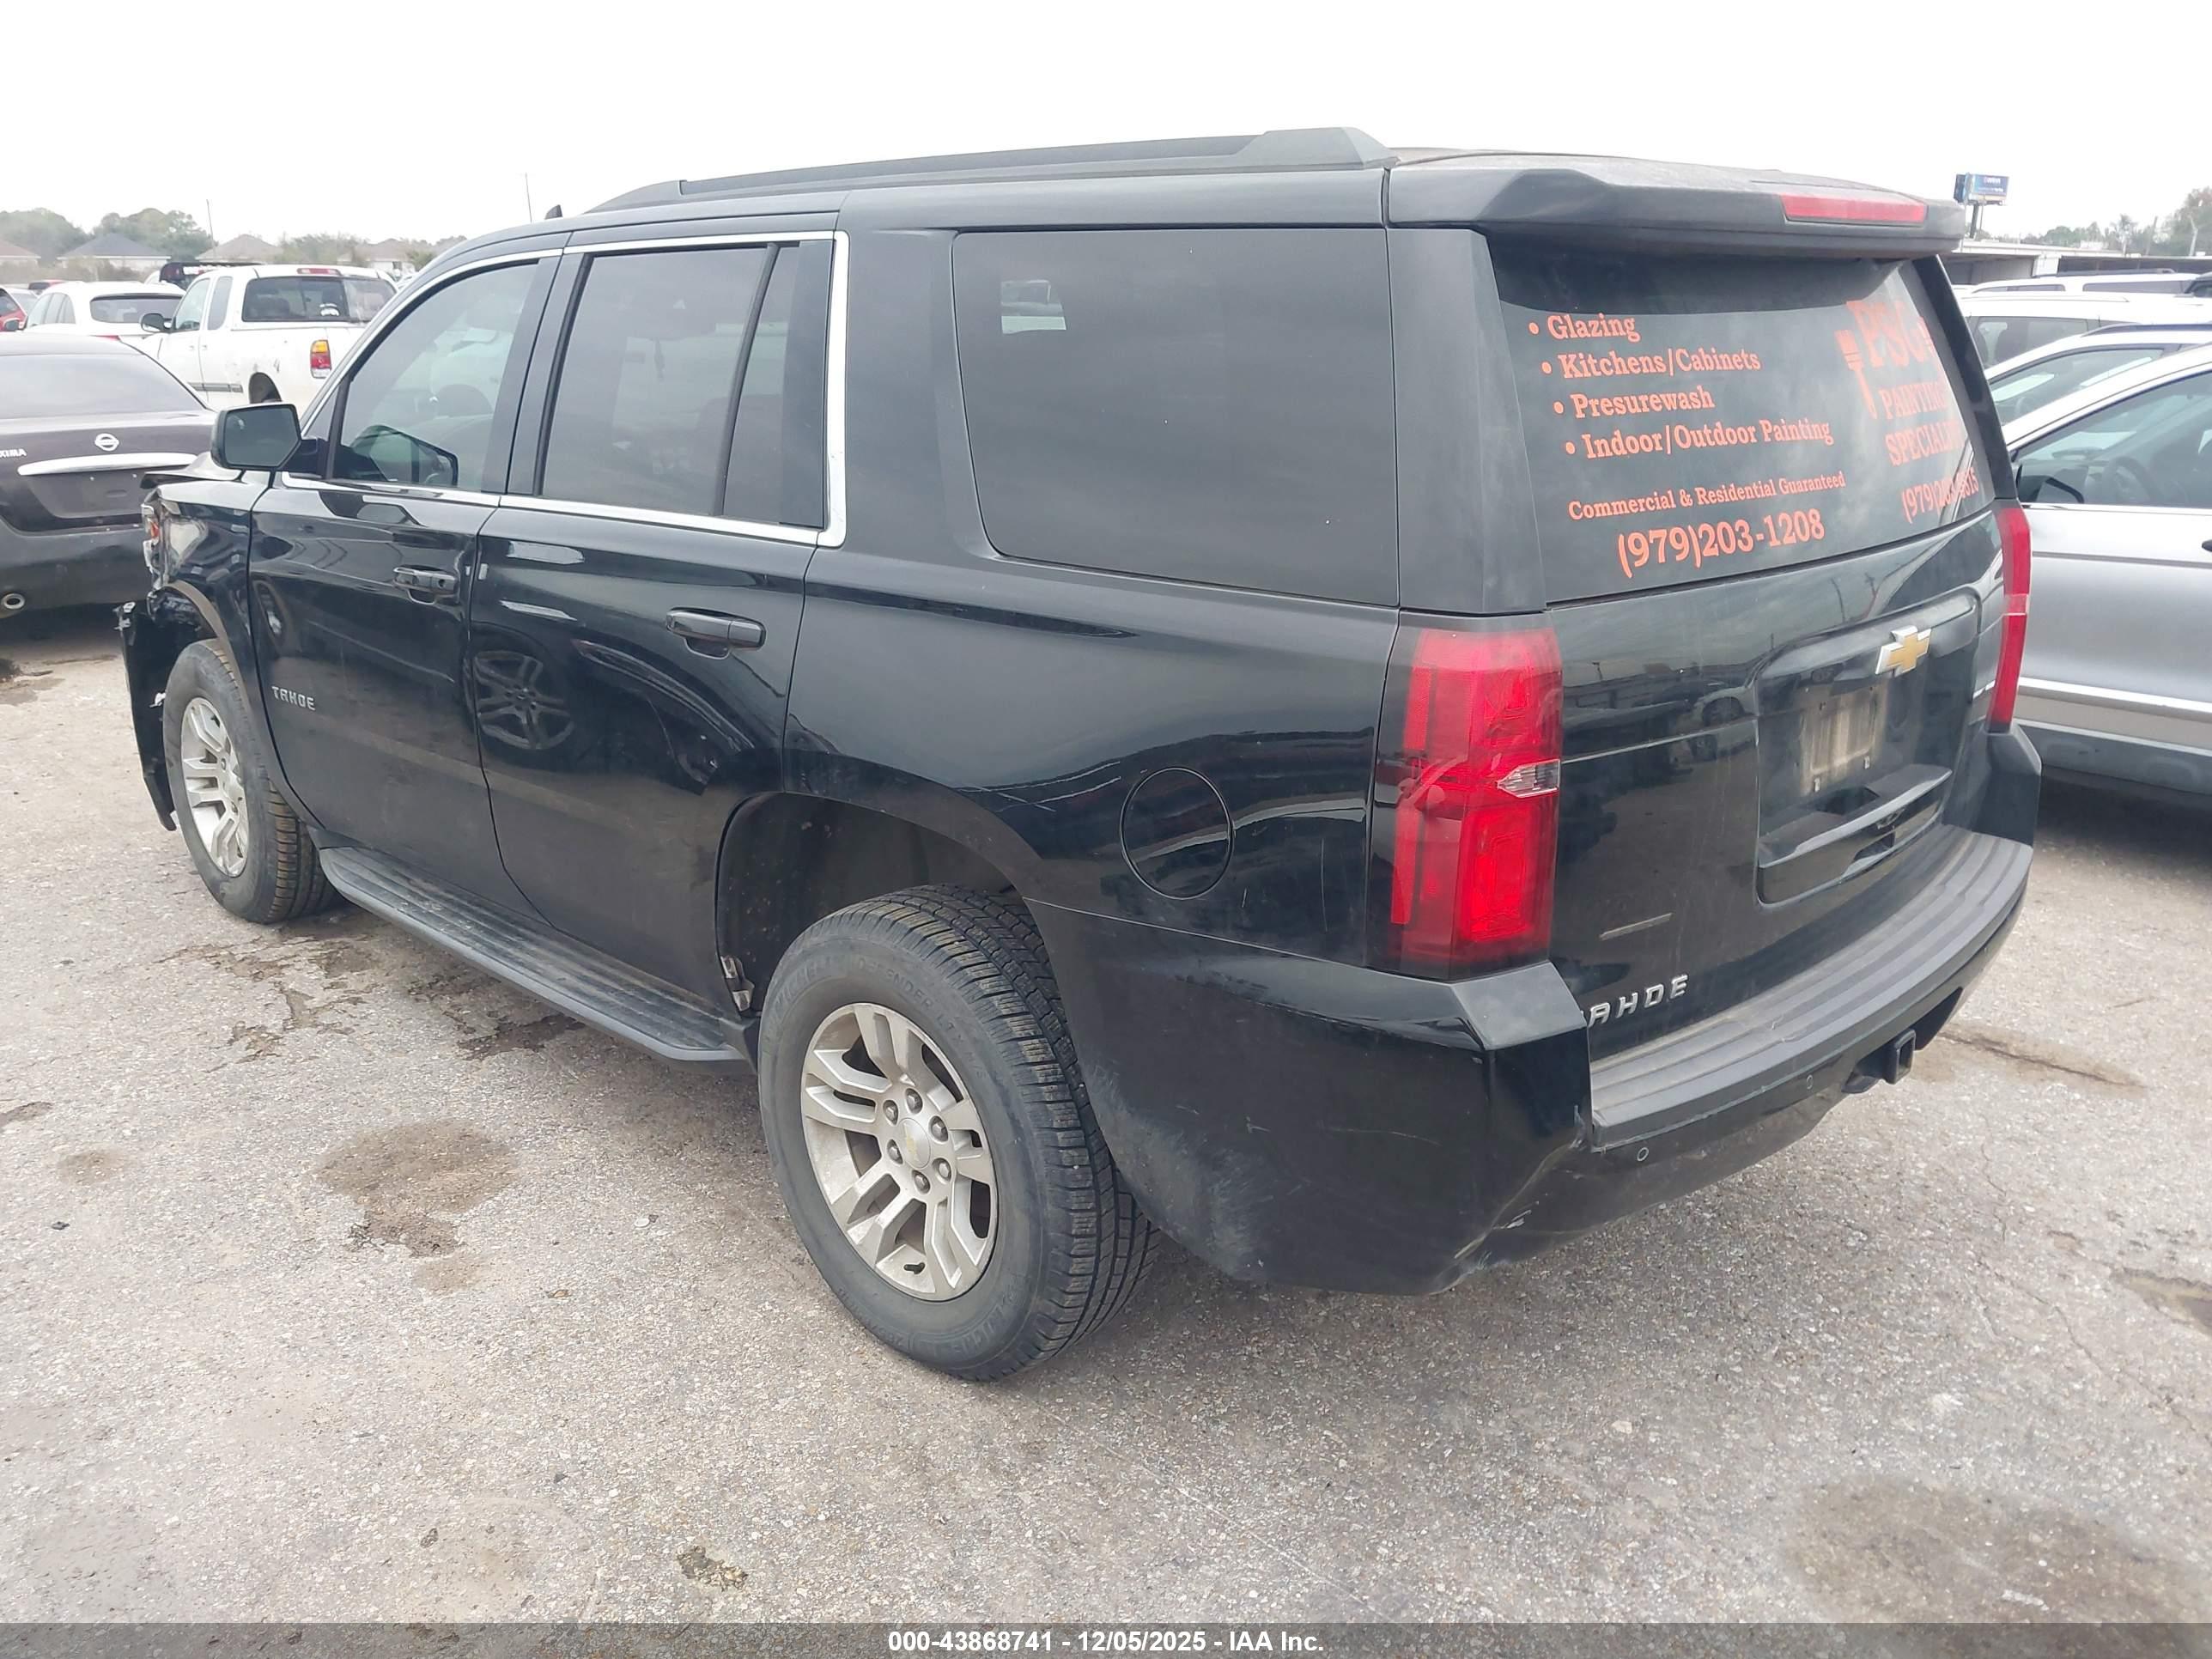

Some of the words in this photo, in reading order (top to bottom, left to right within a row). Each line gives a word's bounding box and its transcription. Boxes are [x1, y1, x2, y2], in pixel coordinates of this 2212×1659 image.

[1547, 313, 1641, 343] Glazing
[1558, 348, 1761, 379] Kitchens/Cabinets
[1570, 385, 1716, 419] Presurewash
[1582, 422, 1757, 459] Indoor/Outdoor
[1759, 416, 1834, 447] Painting
[1568, 489, 1676, 520] Commercial
[1680, 489, 1693, 507] &
[1697, 478, 1778, 507] Residential
[1778, 470, 1847, 497] Guaranteed
[1616, 507, 1826, 579] (979)203-1208
[271, 685, 316, 712] TAHOE
[1581, 974, 1688, 1028] AHOE
